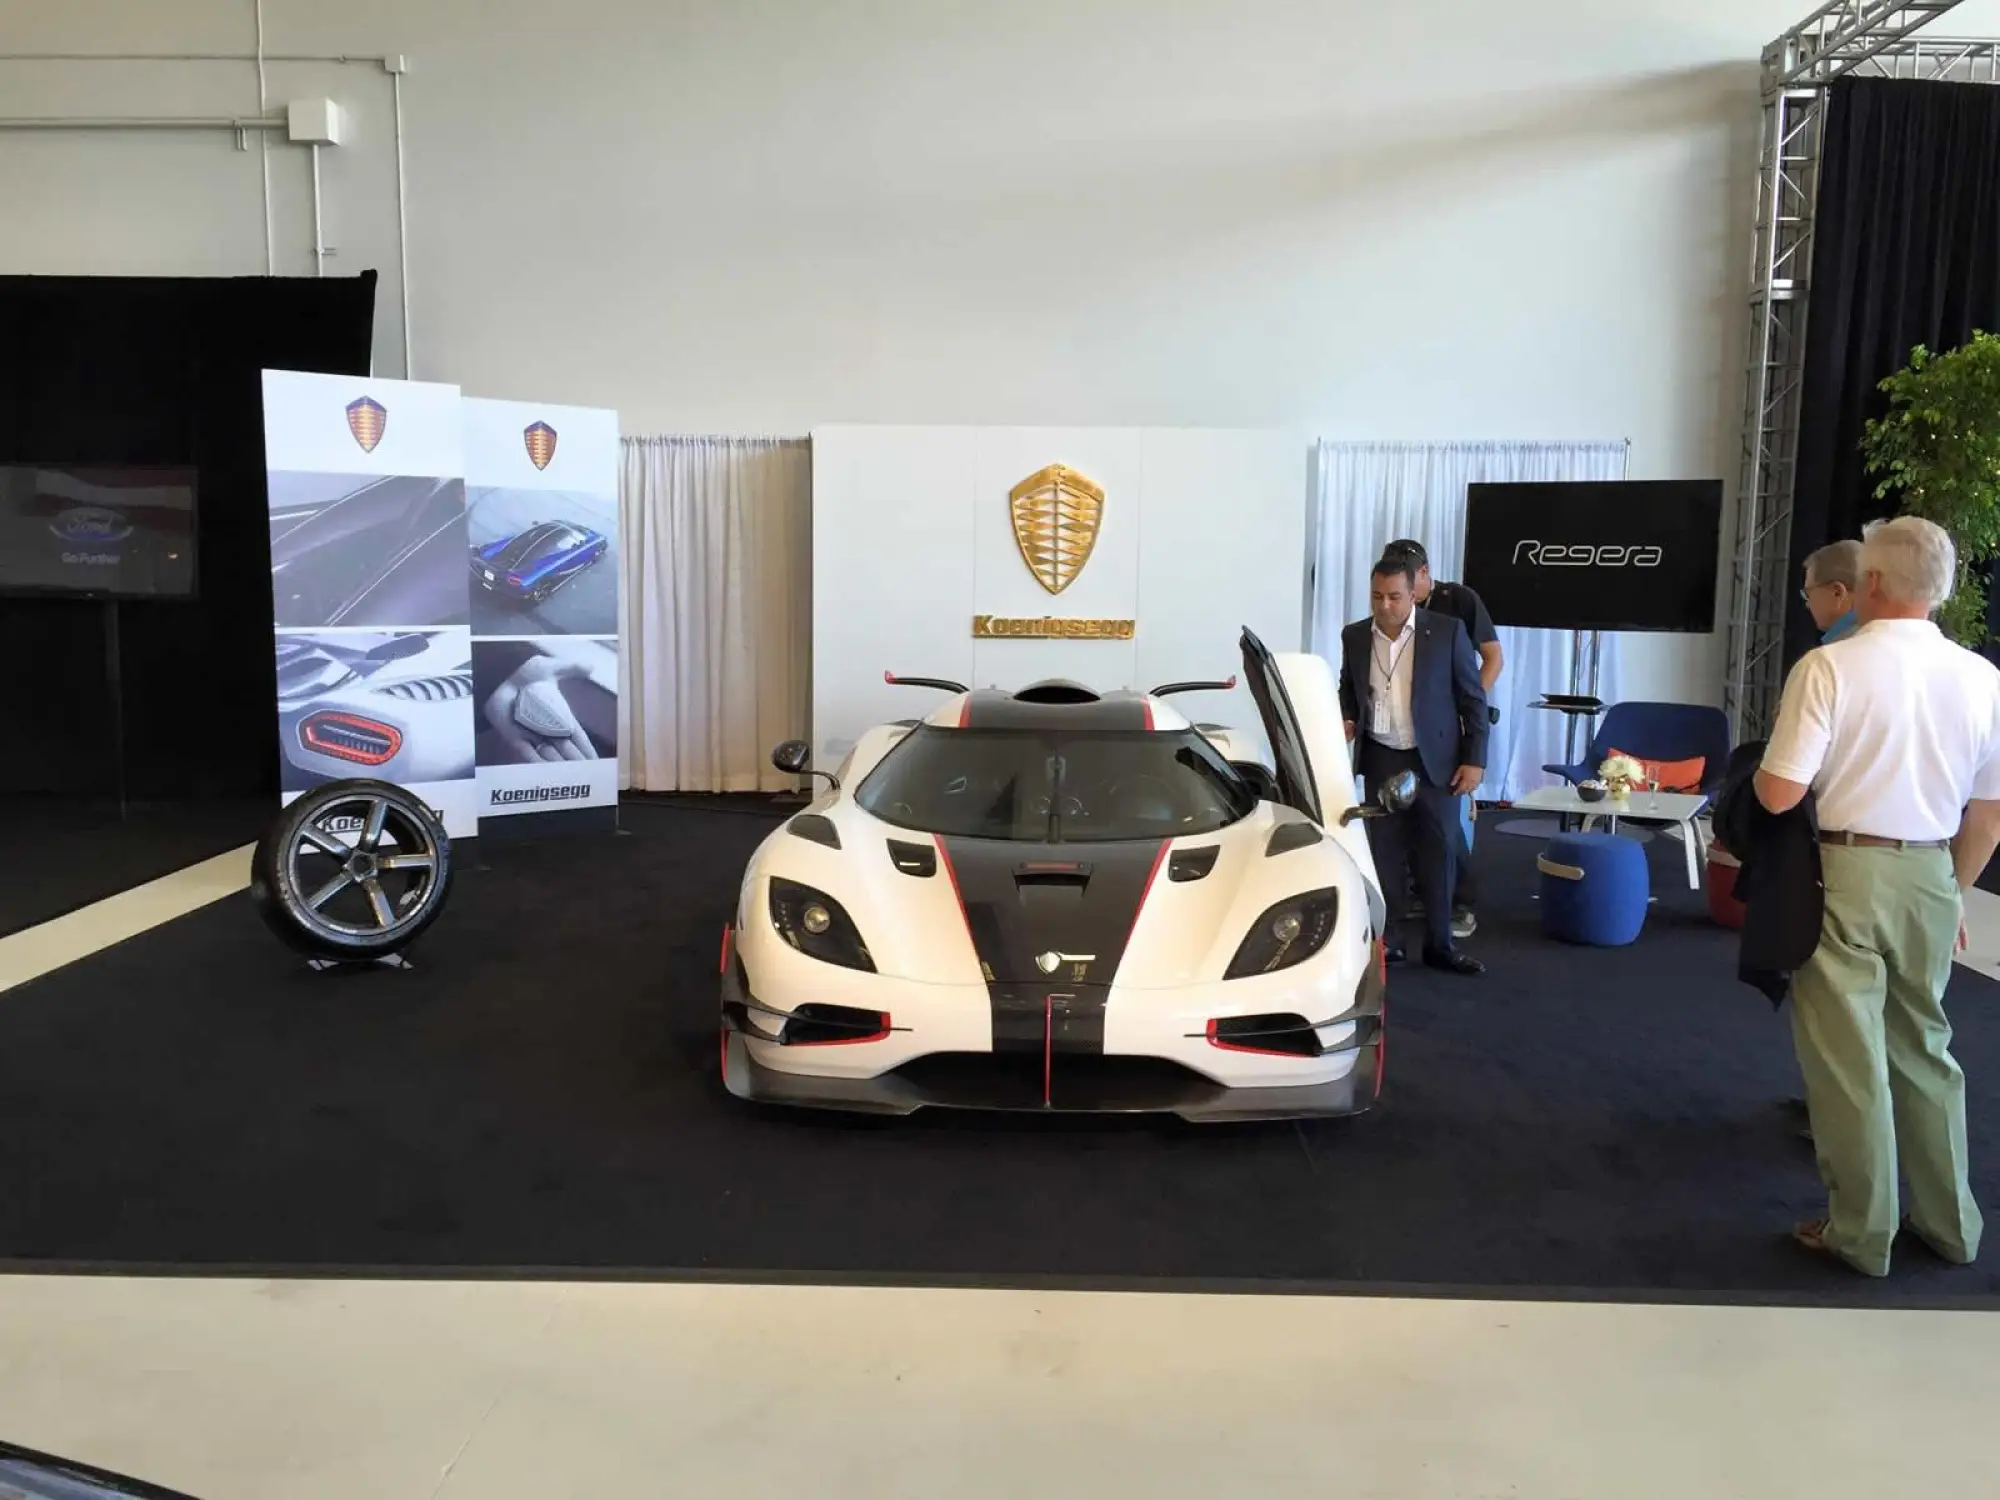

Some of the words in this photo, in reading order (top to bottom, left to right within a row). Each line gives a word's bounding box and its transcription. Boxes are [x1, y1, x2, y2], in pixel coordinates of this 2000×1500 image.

[61, 552, 78, 564] Go
[1512, 539, 1662, 567] Regera
[972, 614, 1136, 640] Koenigsegg
[490, 784, 591, 805] Koenigsegg
